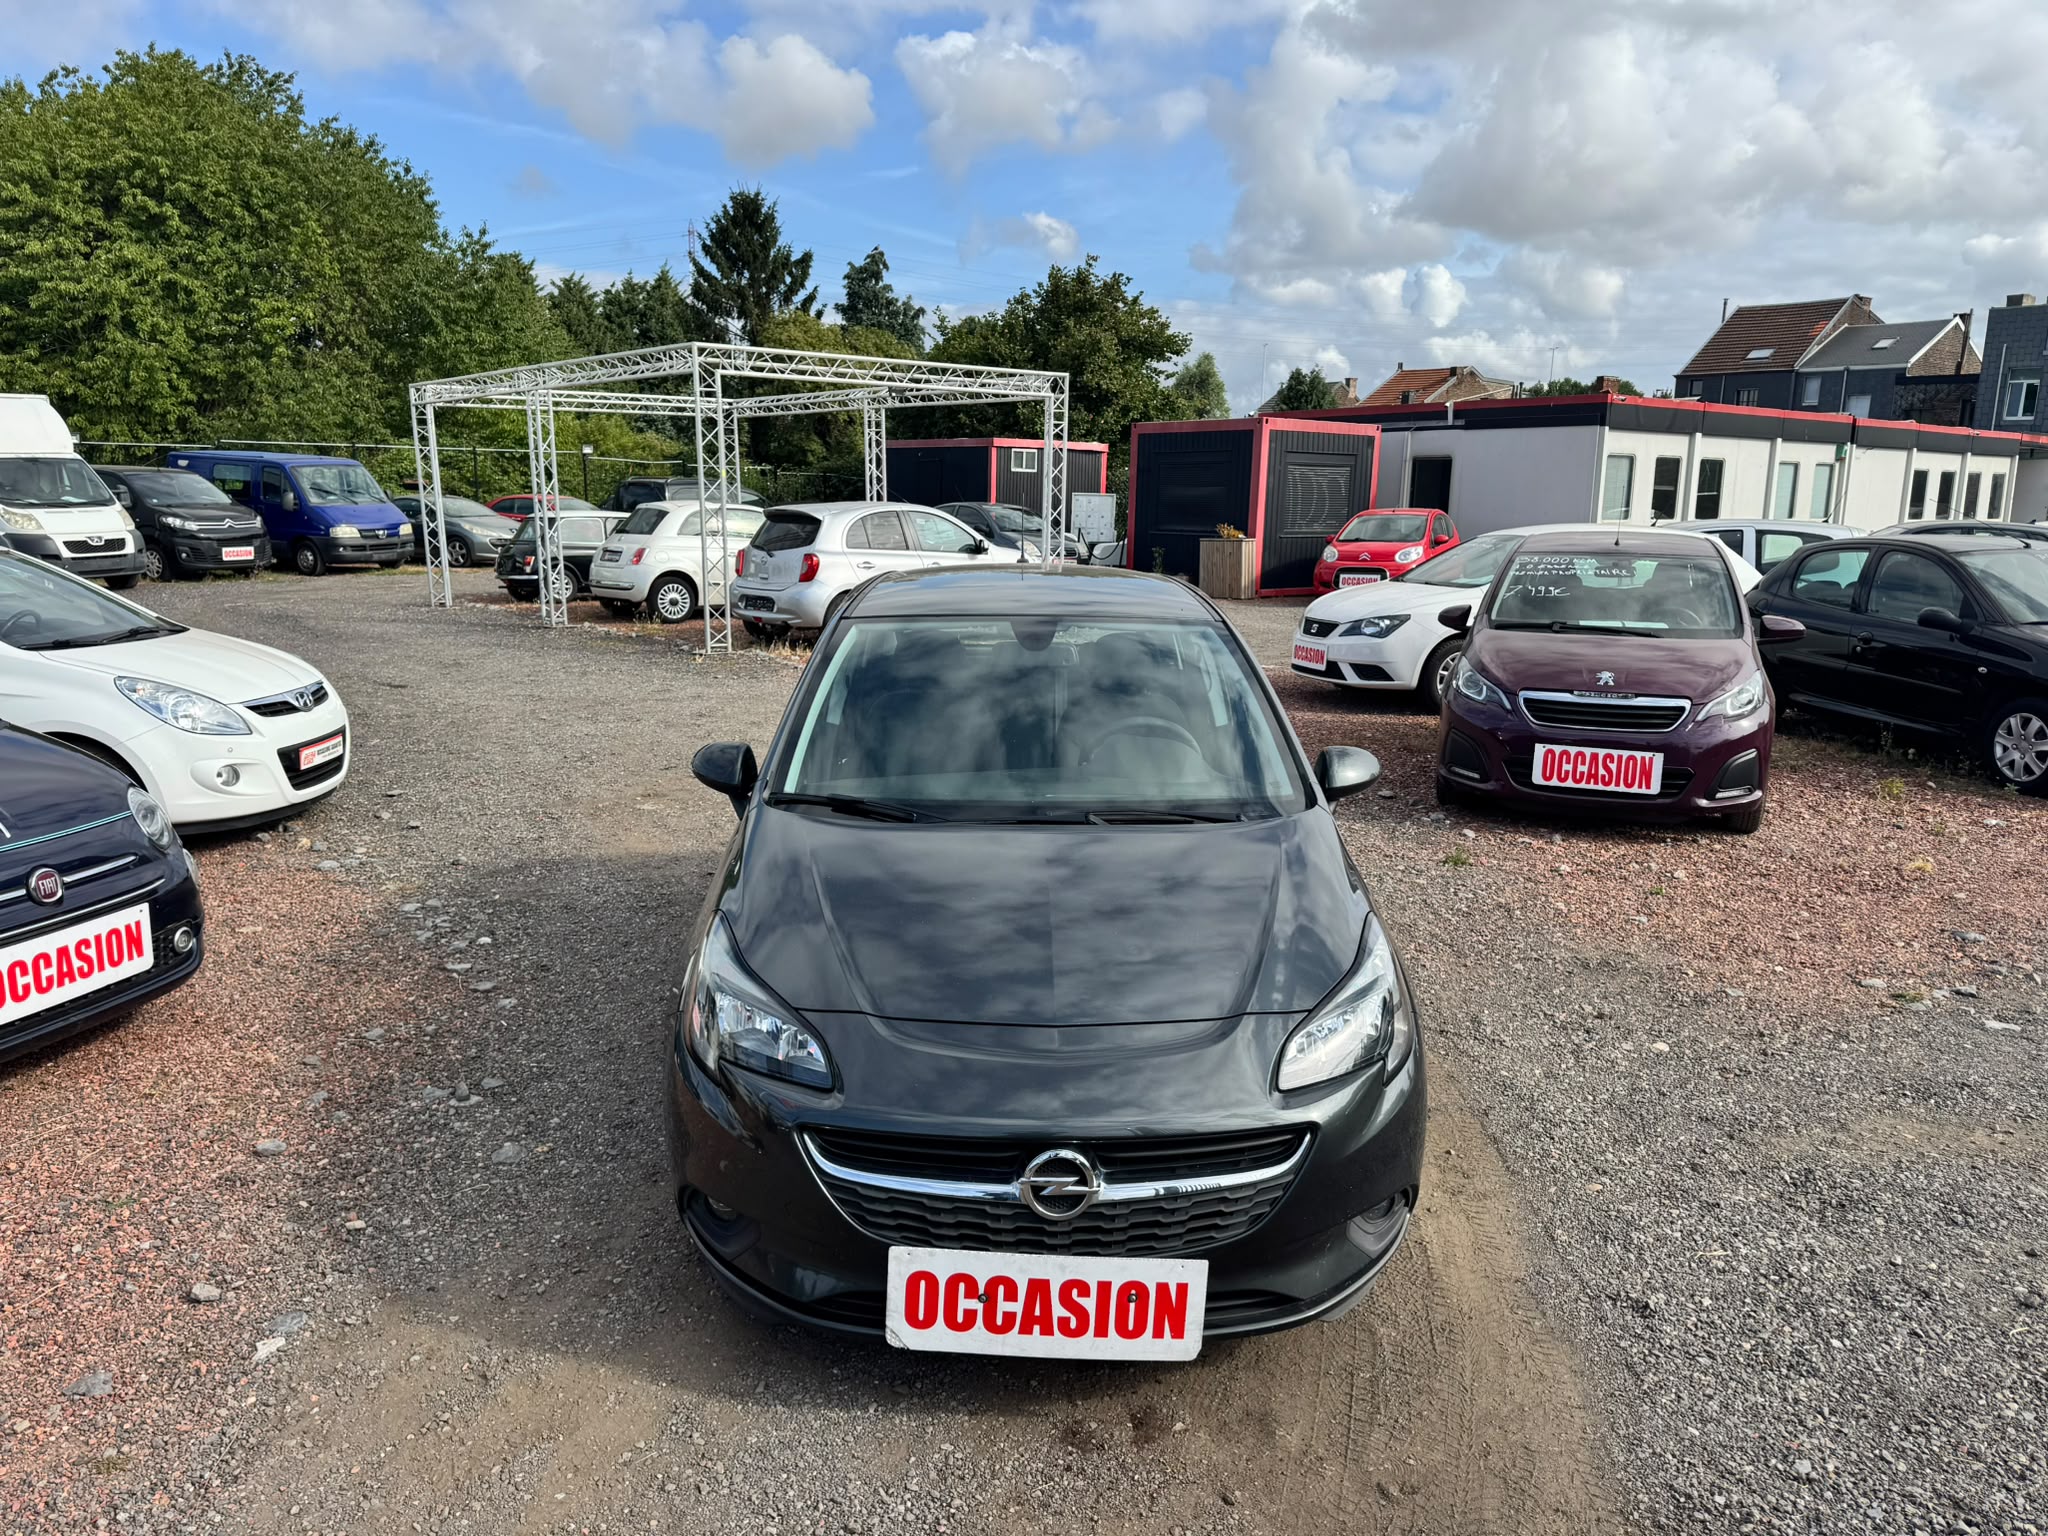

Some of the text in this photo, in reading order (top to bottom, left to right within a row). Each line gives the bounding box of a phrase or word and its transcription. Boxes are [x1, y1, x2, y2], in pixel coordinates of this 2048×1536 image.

[224, 549, 253, 559] OCCASION
[1294, 644, 1325, 665] OCCASION
[1541, 748, 1654, 790] OCCASION
[38, 877, 58, 896] FIAT
[0, 919, 145, 1009] CCASION
[904, 1270, 1189, 1340] OCCASION
